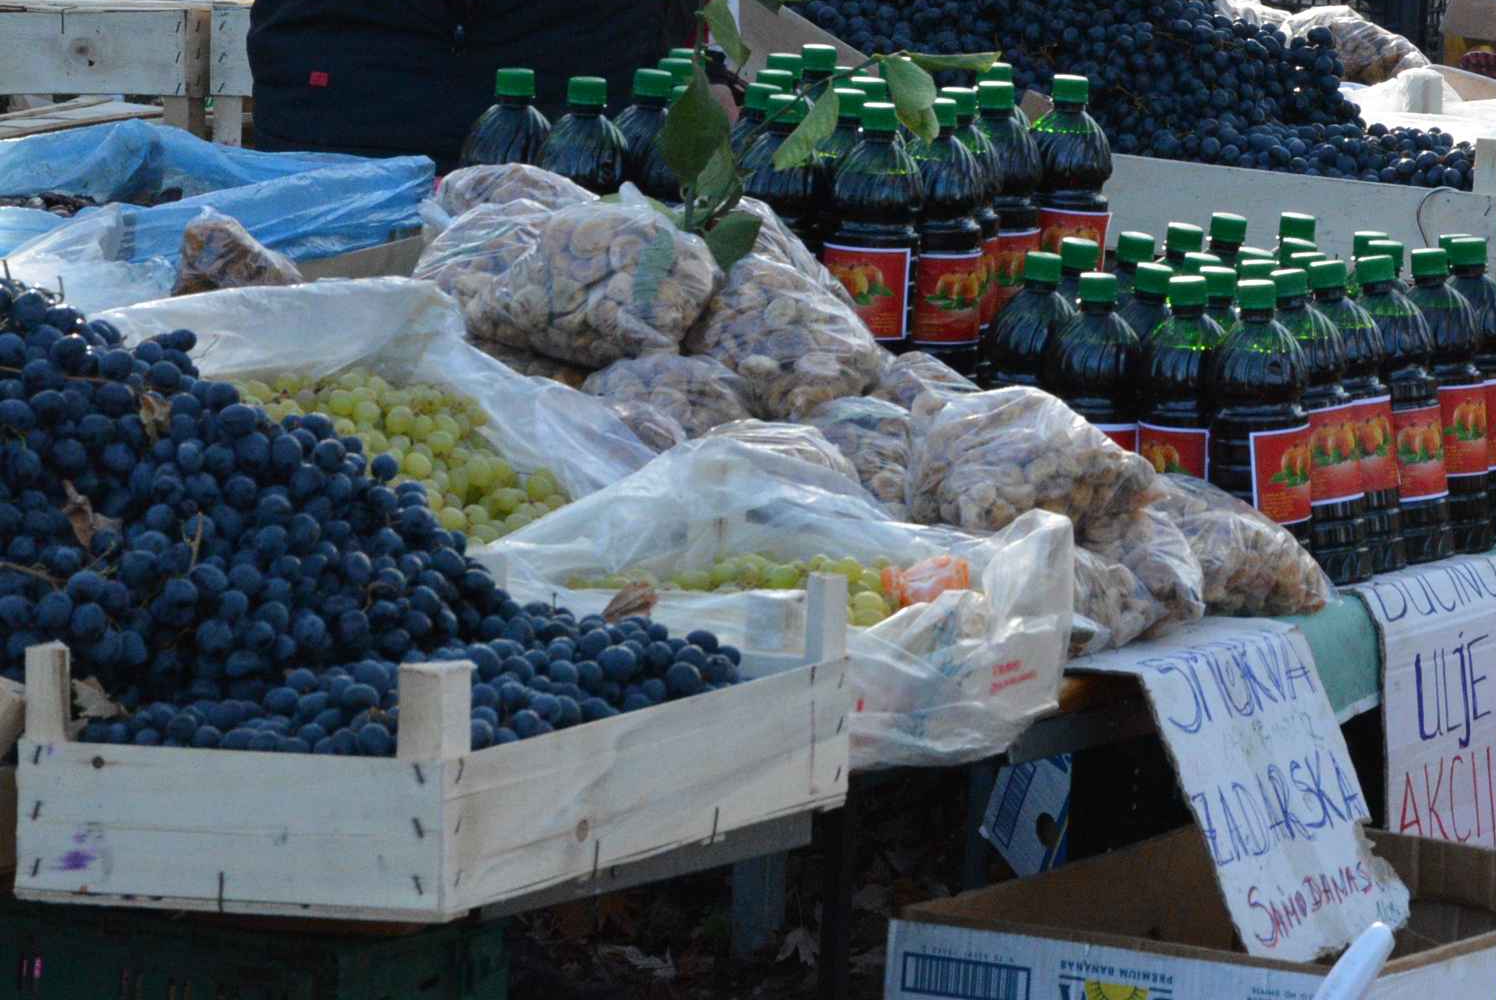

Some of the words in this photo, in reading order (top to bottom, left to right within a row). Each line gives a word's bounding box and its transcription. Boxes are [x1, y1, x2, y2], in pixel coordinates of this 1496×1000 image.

[1414, 631, 1492, 750] ULJE
[1191, 748, 1370, 867] ZADARSKA
[1059, 959, 1115, 977] BANANAS
[1119, 967, 1173, 985] PREMIUM
